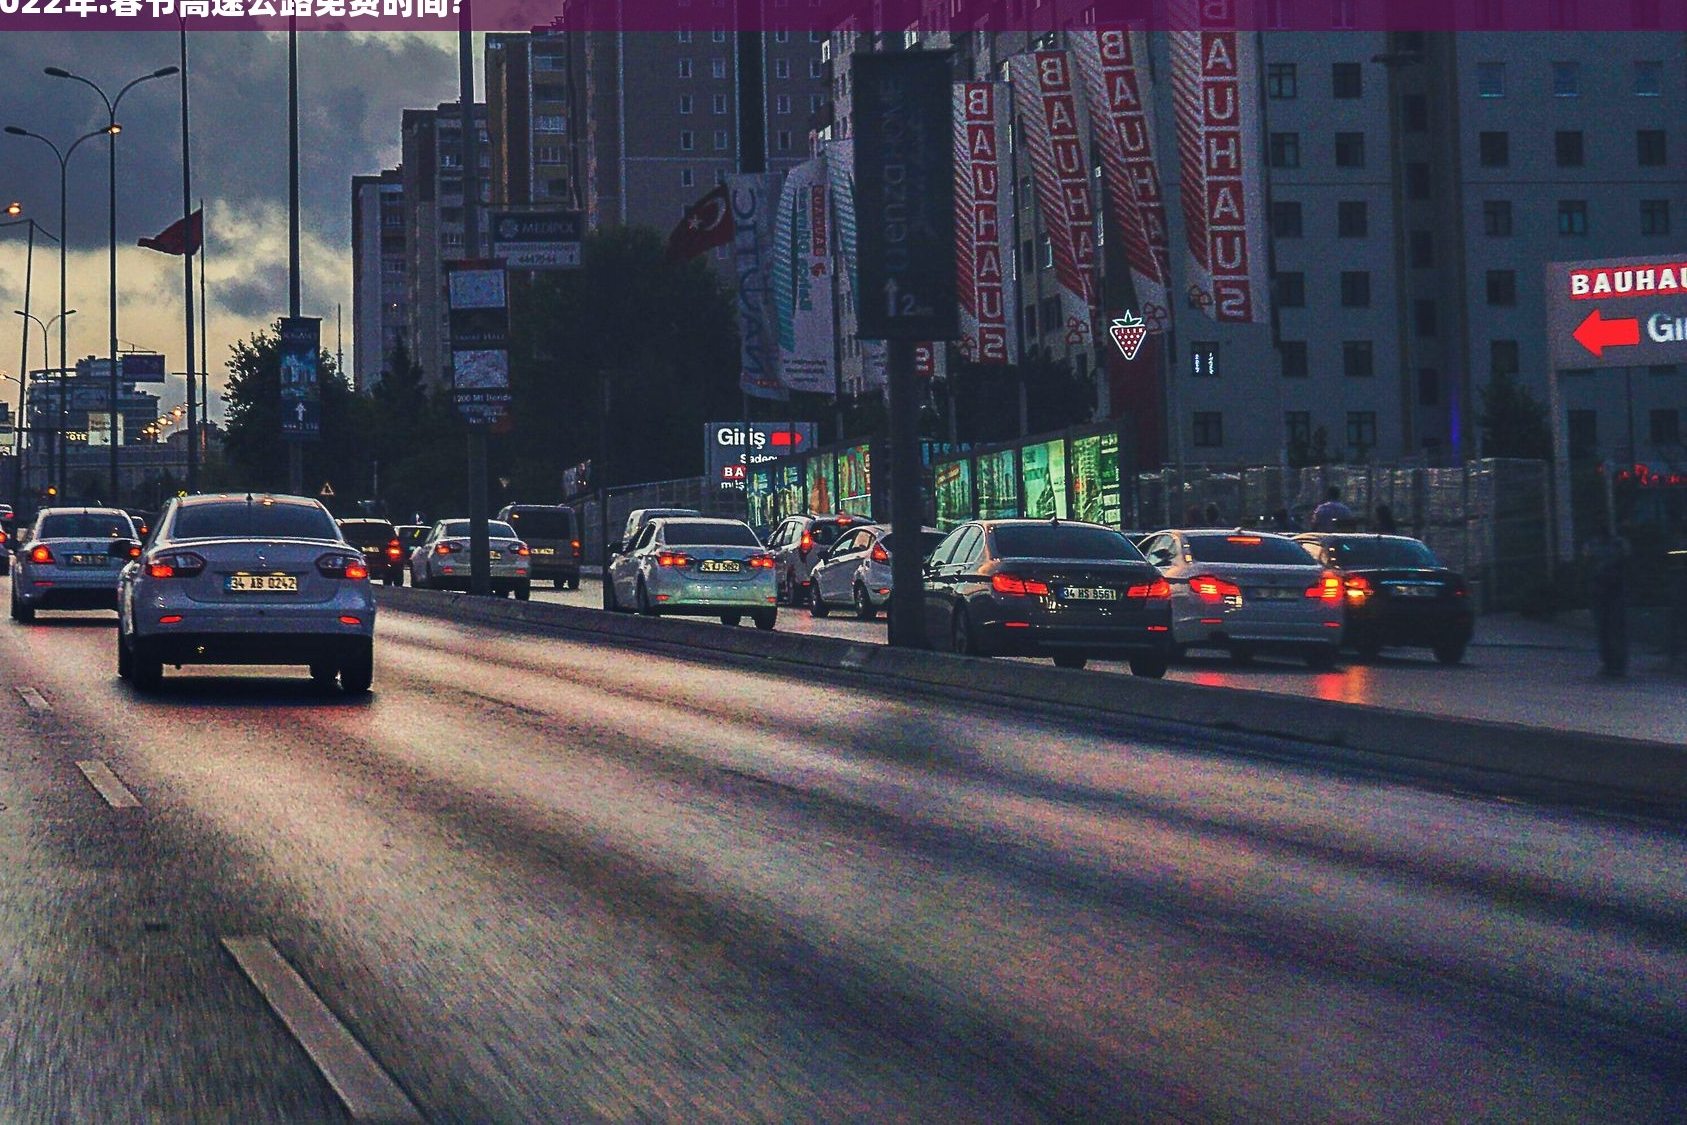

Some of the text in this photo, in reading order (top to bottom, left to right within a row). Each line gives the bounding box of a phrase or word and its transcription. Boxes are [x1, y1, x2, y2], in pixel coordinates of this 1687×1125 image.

[717, 427, 766, 450] Giriş
[231, 577, 296, 589] 34 AB 0242
[1064, 588, 1076, 598] 34
